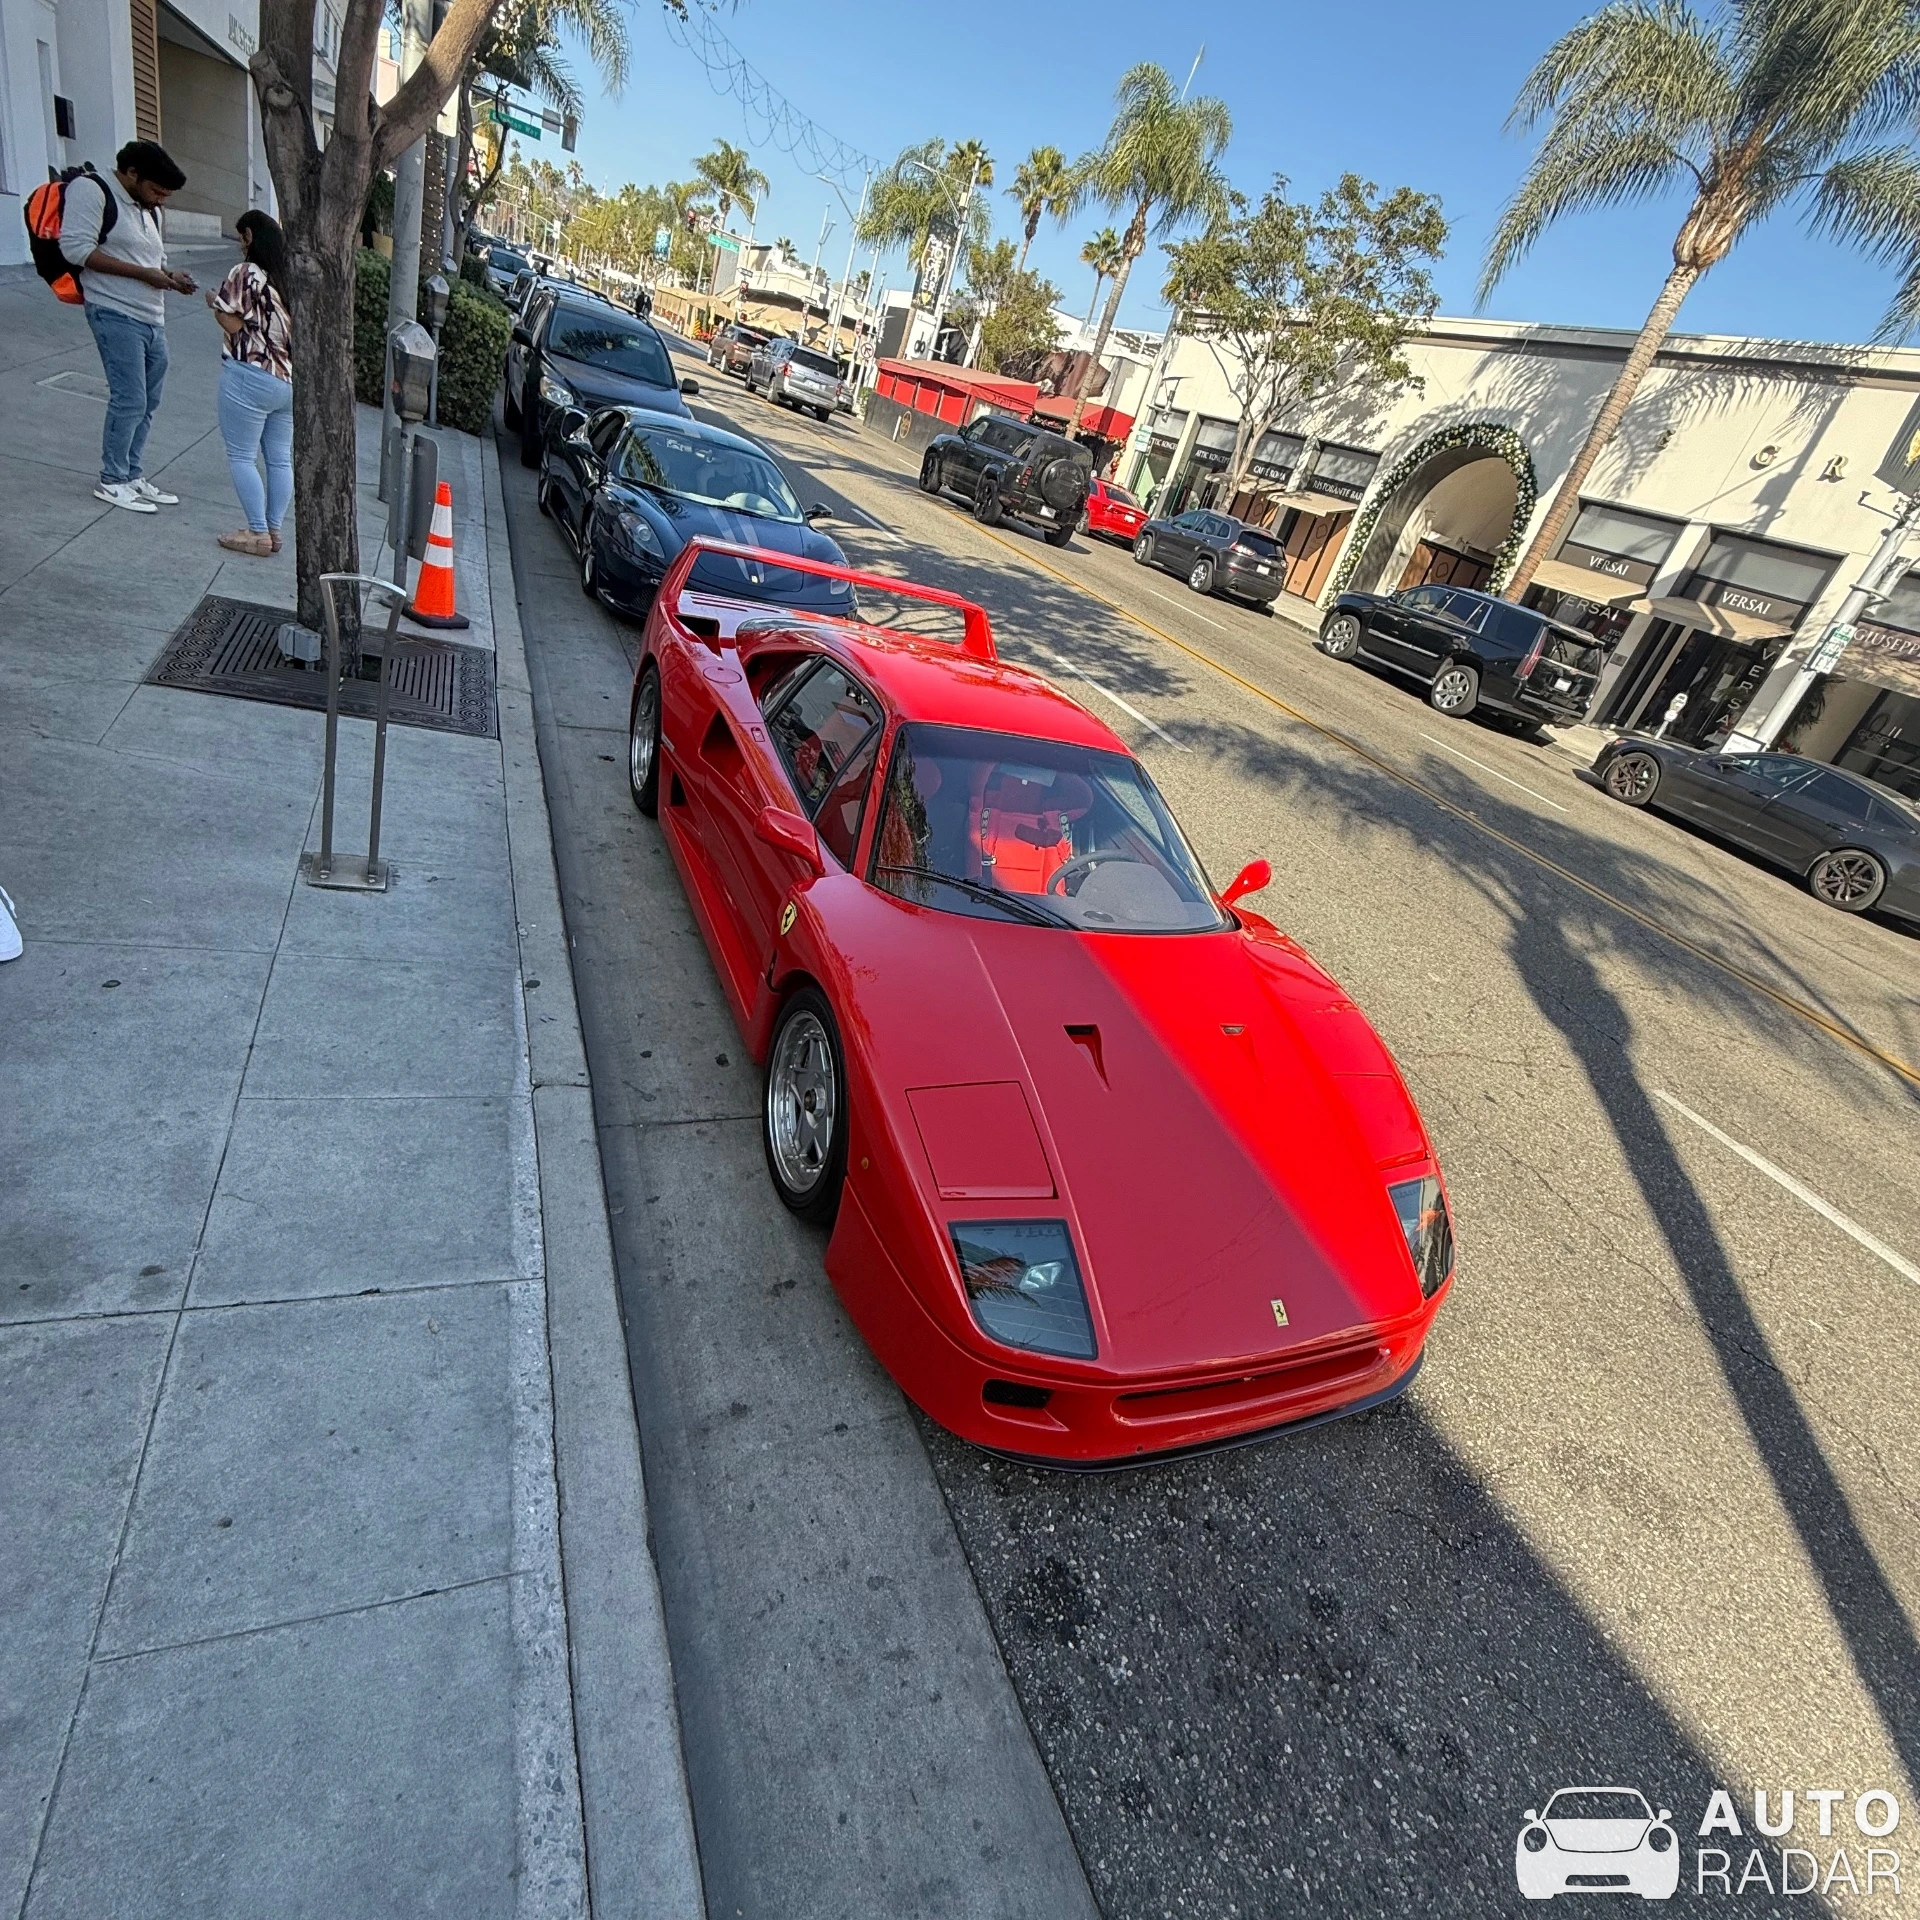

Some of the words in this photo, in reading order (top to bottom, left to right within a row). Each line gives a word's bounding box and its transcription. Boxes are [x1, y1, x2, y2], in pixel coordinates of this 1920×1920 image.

[1349, 490, 1364, 500] BAR
[1589, 555, 1629, 576] VERSAI
[1557, 591, 1620, 621] VERSAI
[1721, 590, 1772, 615] VERSAI
[1854, 628, 1920, 658] GIUSEPP
